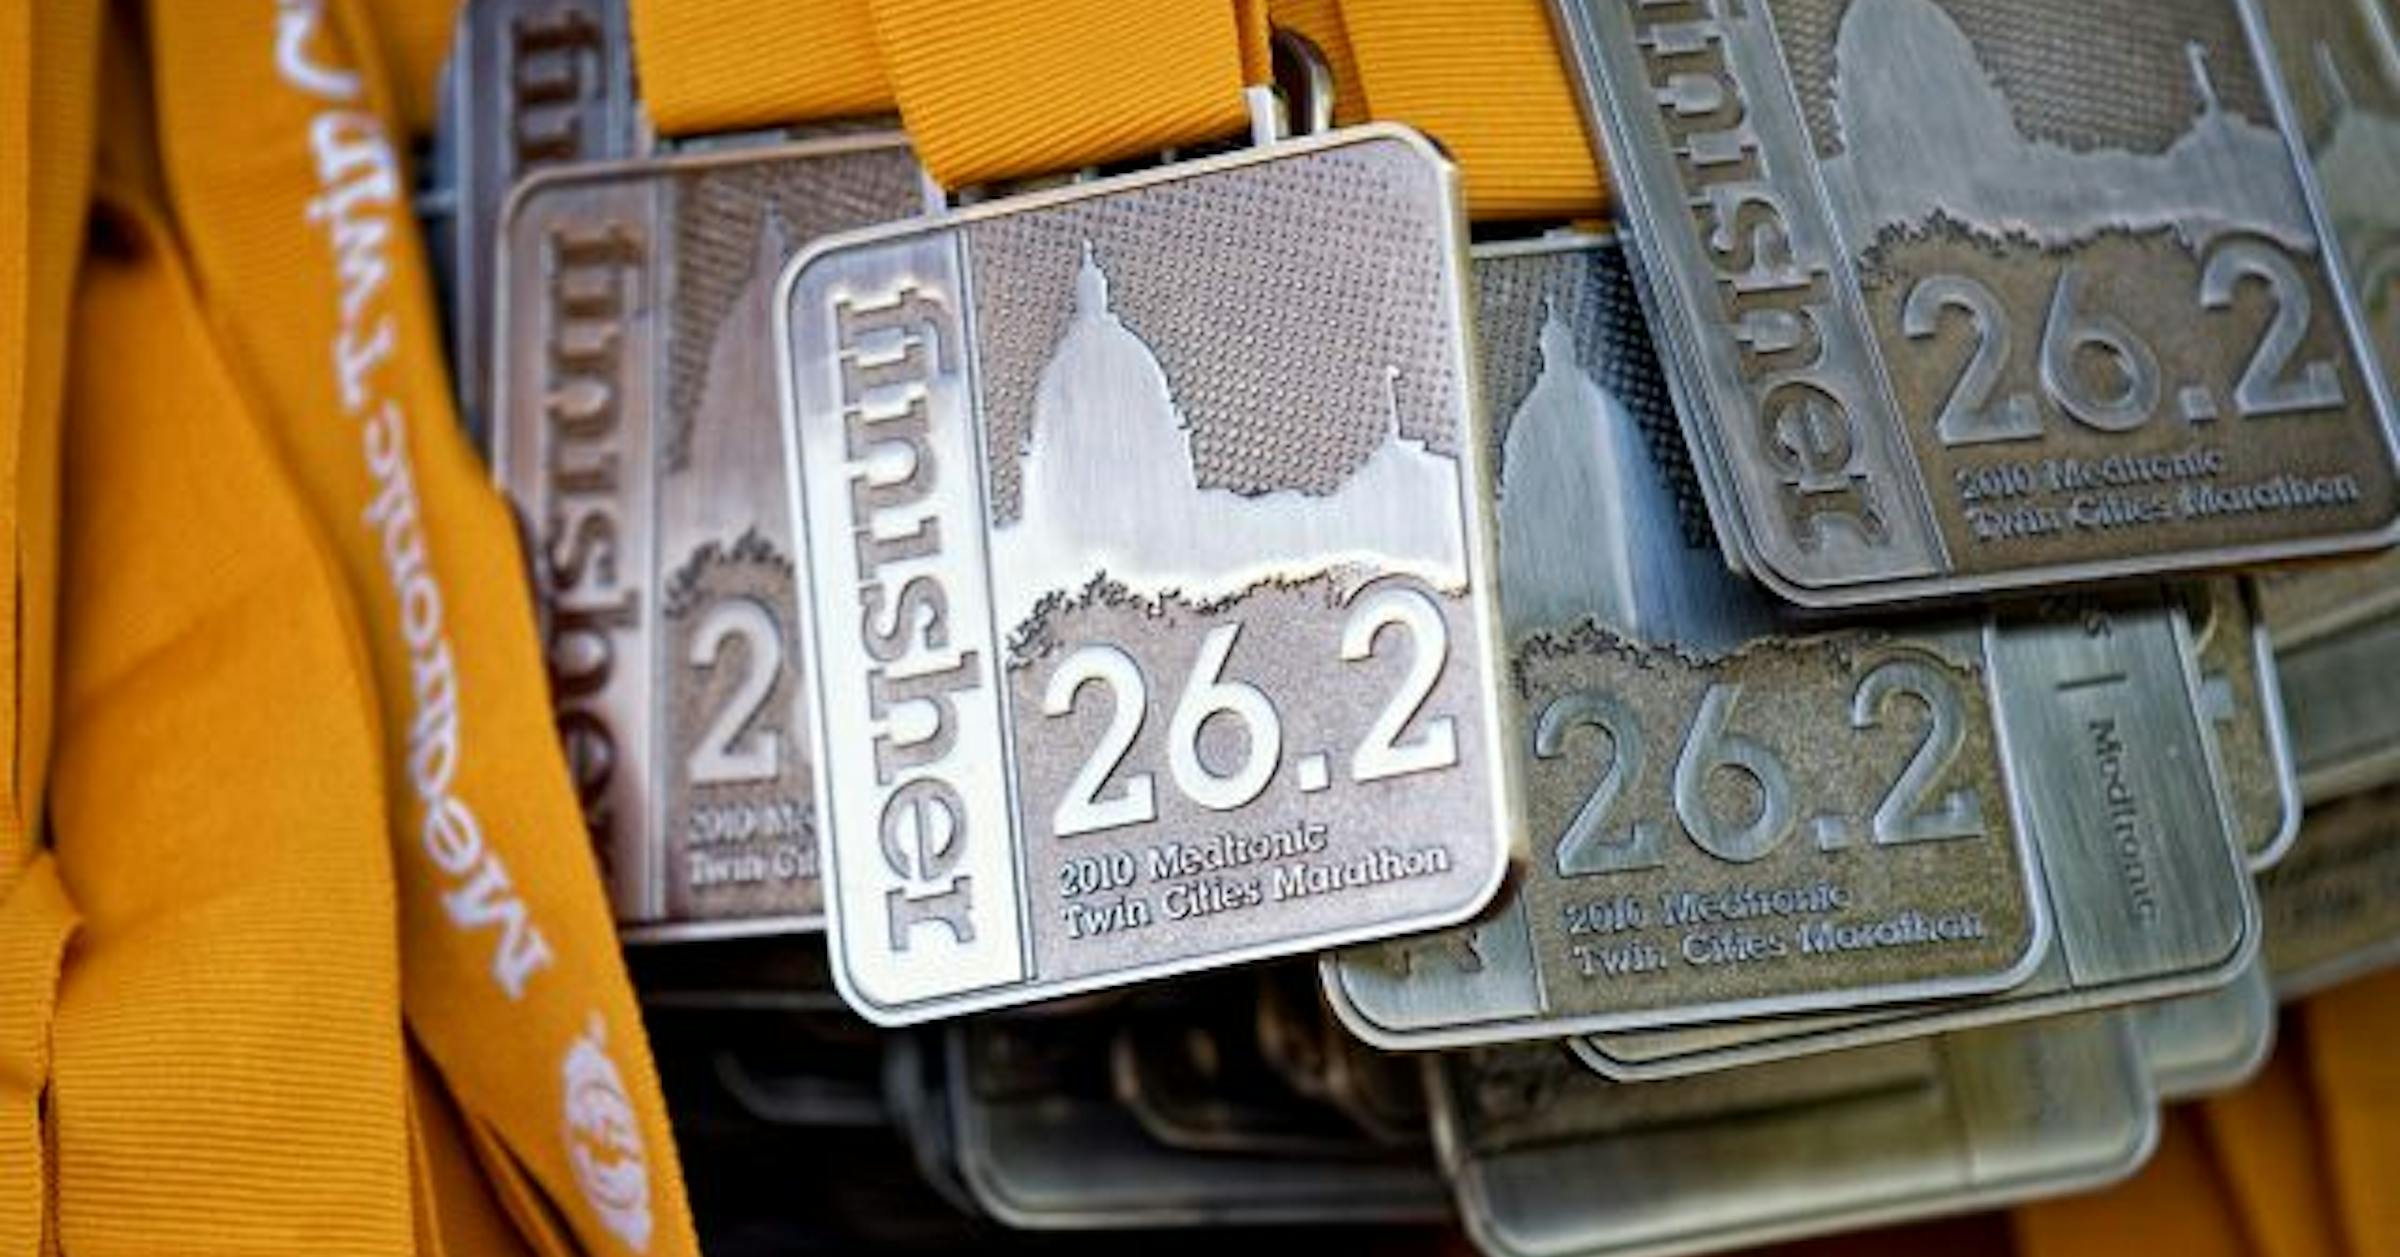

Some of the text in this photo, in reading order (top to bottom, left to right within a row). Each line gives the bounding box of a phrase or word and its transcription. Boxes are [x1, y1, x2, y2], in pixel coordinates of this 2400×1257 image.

[306, 110, 398, 414] Twin
[1903, 232, 2345, 448] 26.2
[362, 400, 555, 998] Medtronic
[836, 282, 981, 952] finisher
[1042, 575, 1460, 837] 26.2
[1058, 822, 1328, 898] 2010 Medtronic
[1534, 658, 1986, 878] 26.2
[1061, 846, 1451, 939] Twin Cities Marathon
[1564, 880, 1850, 936] 2010 Medtronic
[1572, 911, 1985, 979] Twin Cities Marathon
